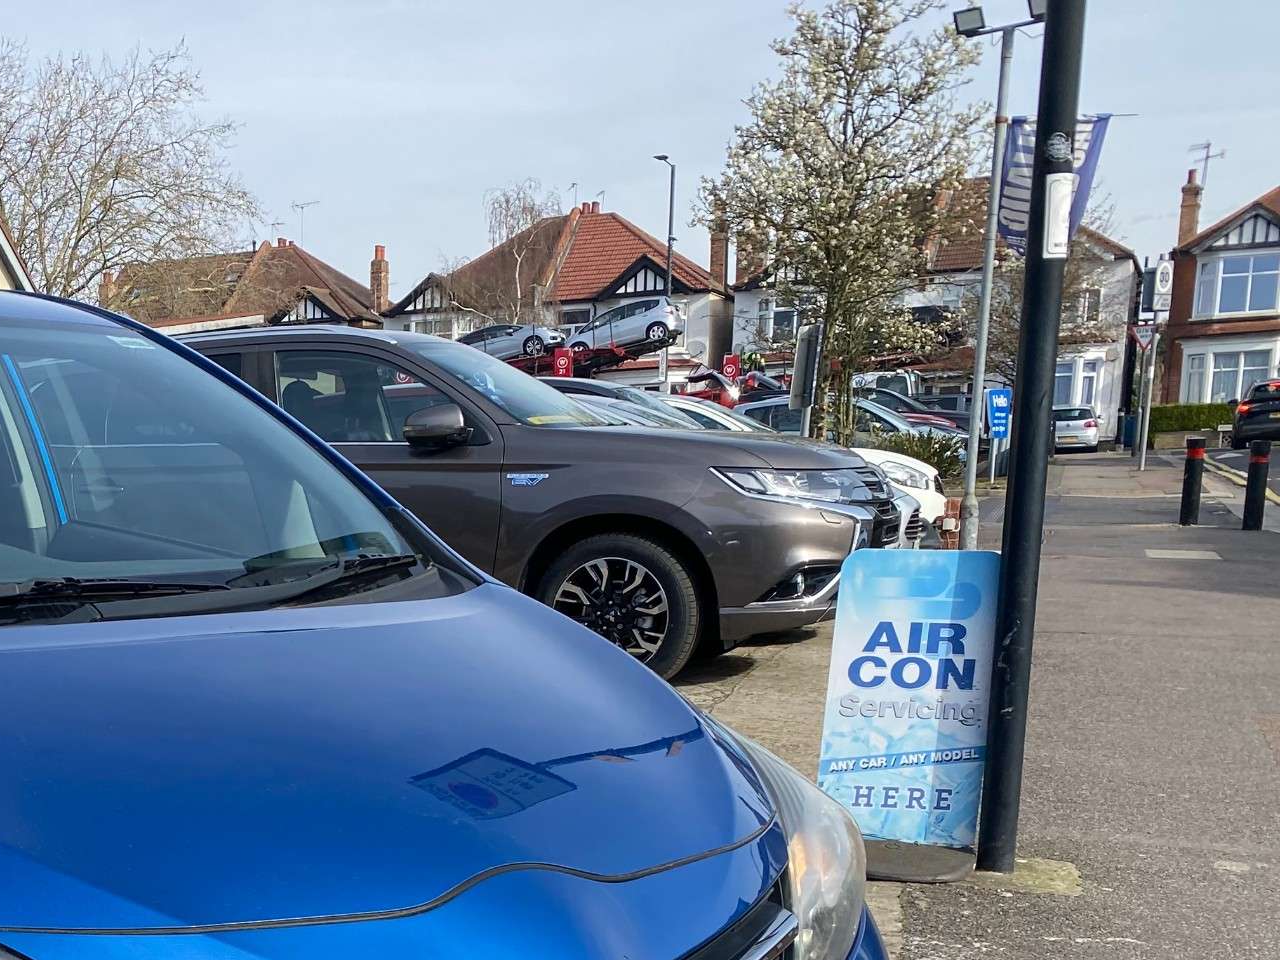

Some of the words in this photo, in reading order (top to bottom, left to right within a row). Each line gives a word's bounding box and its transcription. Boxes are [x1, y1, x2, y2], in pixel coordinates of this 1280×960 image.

[862, 621, 967, 655] AIR
[847, 655, 976, 690] CON
[838, 694, 982, 728] Servicing
[829, 760, 856, 773] ANY
[860, 757, 888, 771] CAR
[899, 753, 928, 766] ANY
[931, 749, 980, 764] MODEL
[851, 784, 953, 811] HERE
